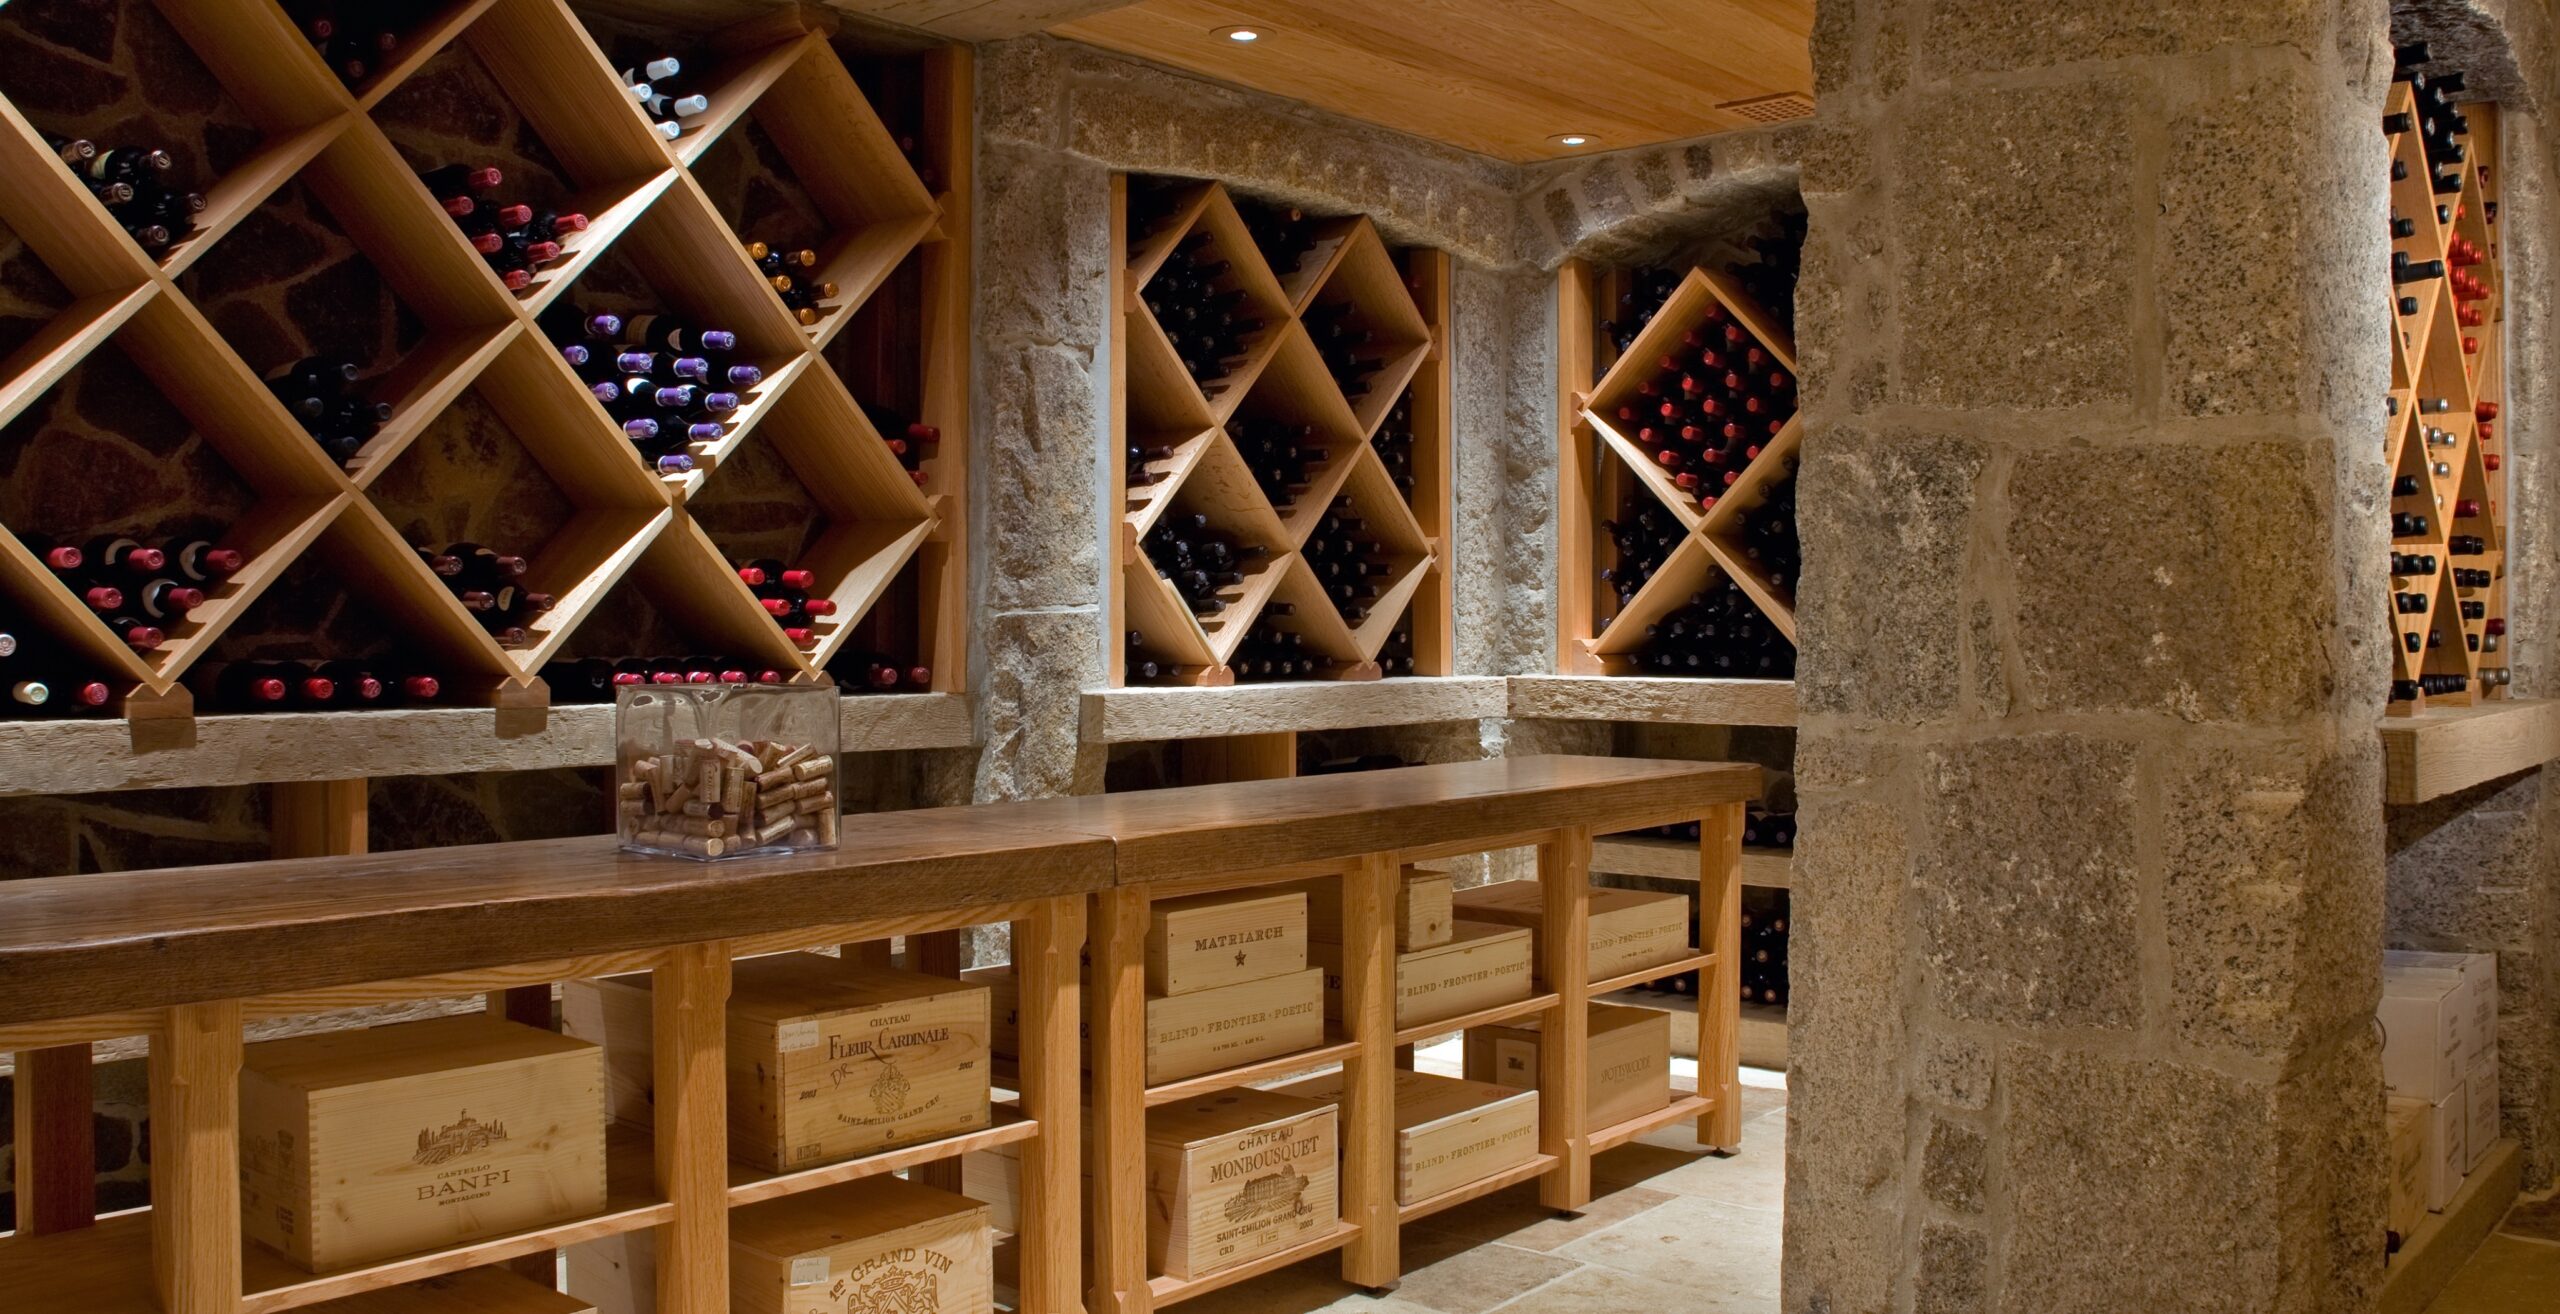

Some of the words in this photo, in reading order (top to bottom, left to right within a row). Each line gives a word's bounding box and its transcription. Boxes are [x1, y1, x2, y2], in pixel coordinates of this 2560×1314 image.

[1195, 926, 1284, 950] MATRIARCH
[1659, 921, 1683, 935] POETIC
[1406, 982, 1437, 997] BLIND
[1443, 969, 1489, 988] FRONTIER
[1495, 960, 1526, 976] POETIC
[870, 1013, 911, 1027] CHATEAU
[1160, 1025, 1199, 1043] BLIND
[1208, 1011, 1267, 1033] FRONTIER
[1274, 1001, 1314, 1020] POETIC
[828, 1034, 880, 1061] FLEUR
[878, 1027, 950, 1051] CARDINALE
[898, 1105, 924, 1120] GRAND
[925, 1094, 941, 1109] CRU
[1239, 1126, 1294, 1150] CHATEAU
[1415, 1154, 1445, 1172] BLIND
[1451, 1137, 1496, 1160] FRONTIER
[1502, 1124, 1533, 1142] POETIC
[437, 1163, 491, 1179] CASTELLO
[1210, 1135, 1320, 1183] MONBOUSQUET
[417, 1169, 511, 1200] BANFI
[439, 1190, 491, 1206] MONTALCINO
[1273, 1208, 1297, 1224] GRAND
[1219, 1244, 1235, 1256] CRD
[851, 1247, 917, 1282] GRAND
[924, 1248, 954, 1273] VIN
